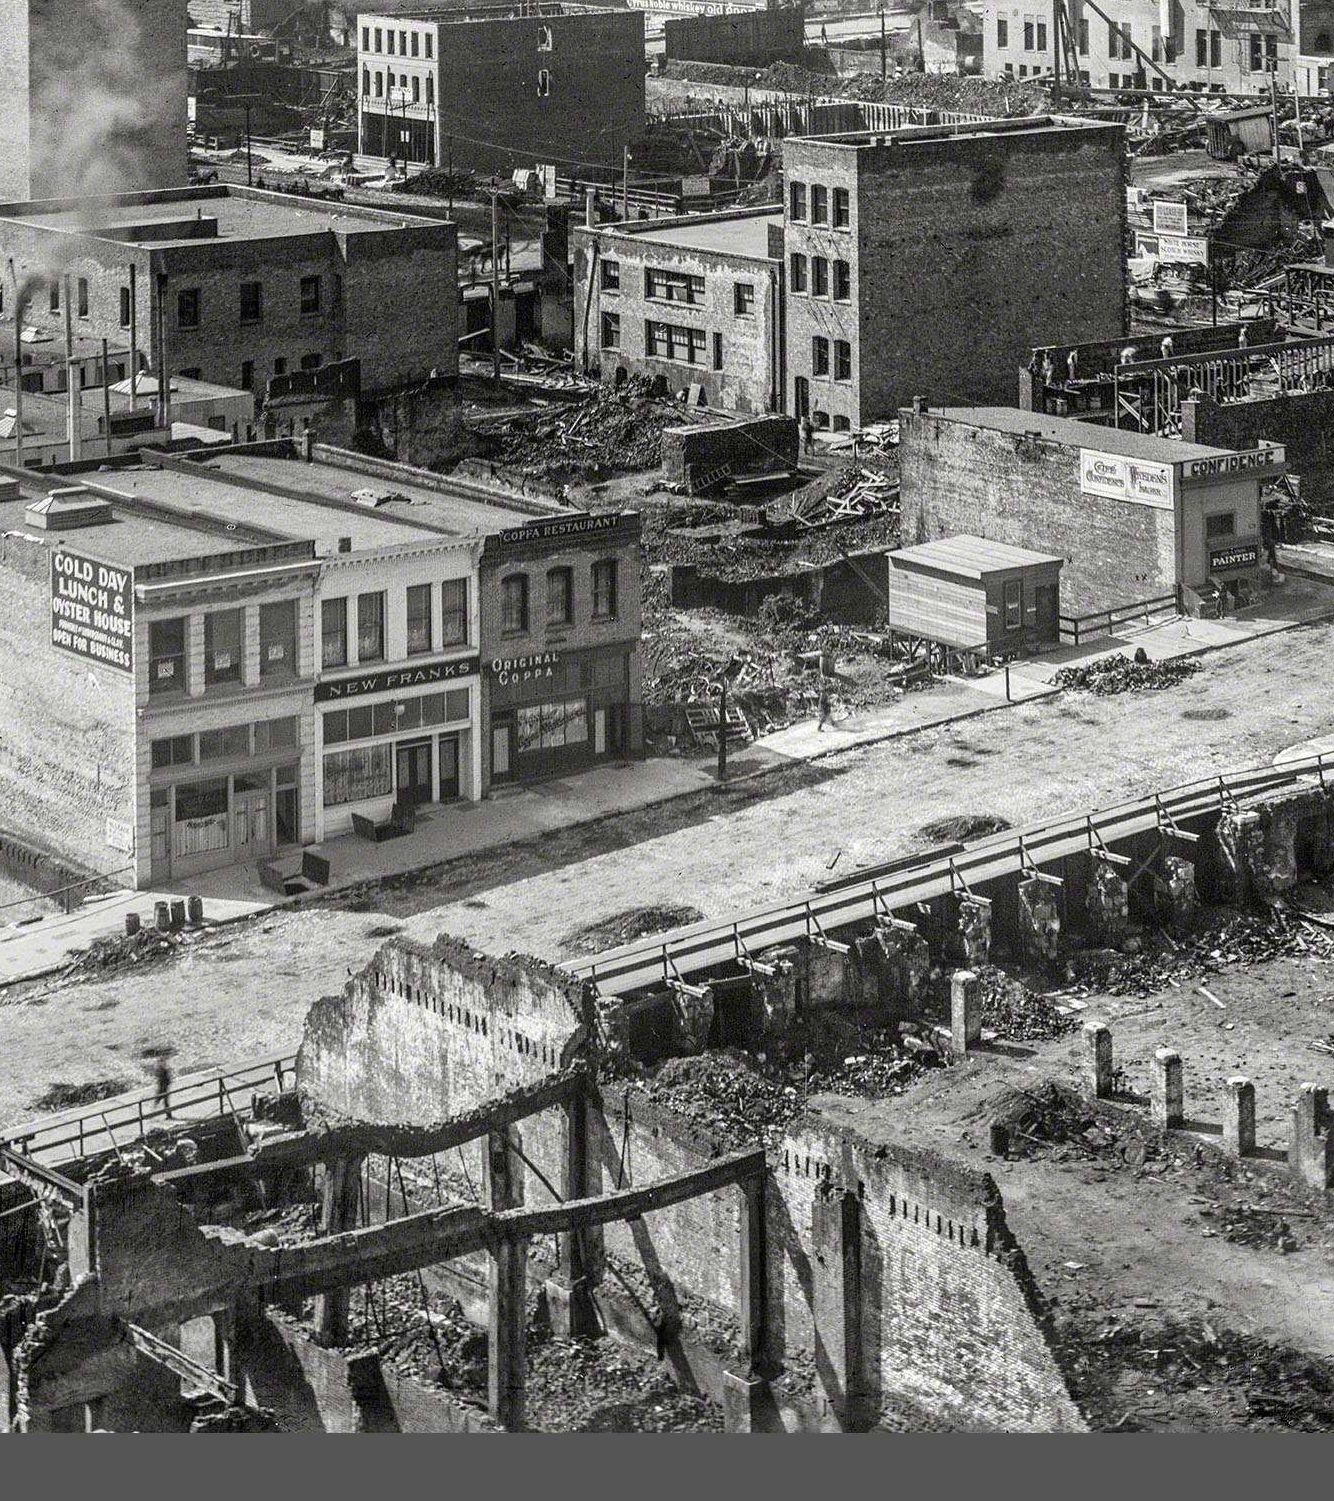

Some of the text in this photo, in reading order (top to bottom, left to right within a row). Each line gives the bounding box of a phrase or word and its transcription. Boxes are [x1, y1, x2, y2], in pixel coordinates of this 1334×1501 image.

[671, 1, 706, 14] whiskey
[707, 4, 724, 15] old
[1190, 450, 1275, 475] CONFIDENCE
[543, 516, 618, 536] RESTAURANT
[1212, 552, 1257, 567] PAINTER
[54, 554, 128, 593] COLD DAY
[58, 576, 125, 615] LUNCH &
[52, 596, 91, 624] OYSTER
[93, 609, 132, 638] HOUSE
[52, 628, 72, 647] OPEN
[73, 634, 87, 652] FOR
[89, 640, 131, 667] BUSINESS
[492, 652, 559, 673] ORIGINAL
[328, 662, 470, 697] NEW FRANKS
[498, 667, 553, 686] COPPA
